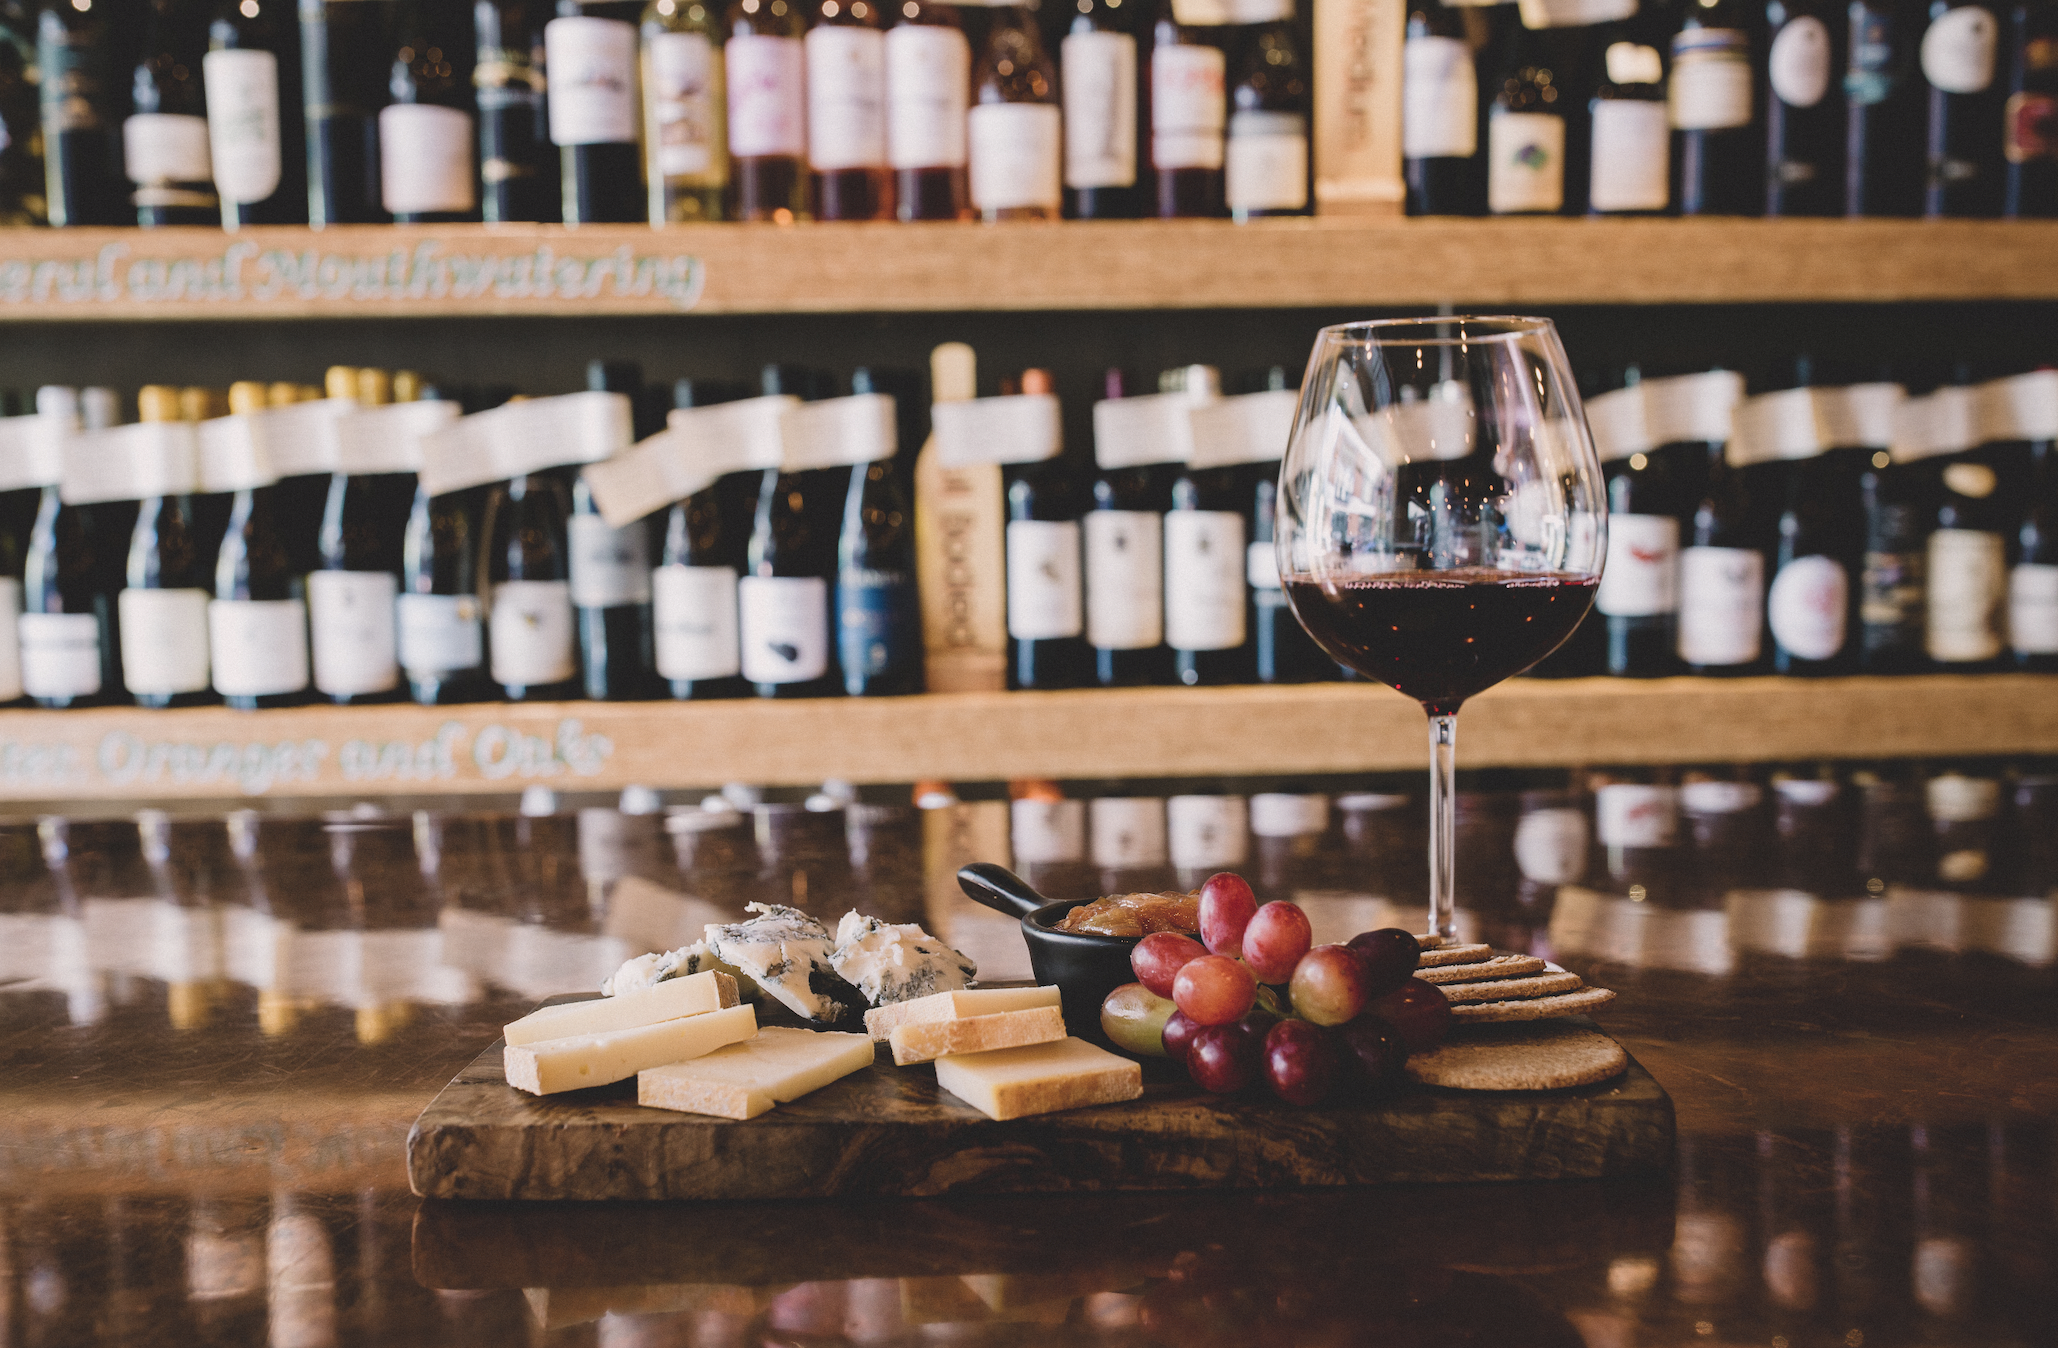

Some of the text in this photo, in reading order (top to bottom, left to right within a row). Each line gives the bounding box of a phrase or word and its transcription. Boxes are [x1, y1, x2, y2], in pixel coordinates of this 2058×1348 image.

[127, 240, 259, 303] and
[252, 240, 706, 311] Mouthwatering
[339, 721, 468, 781] and
